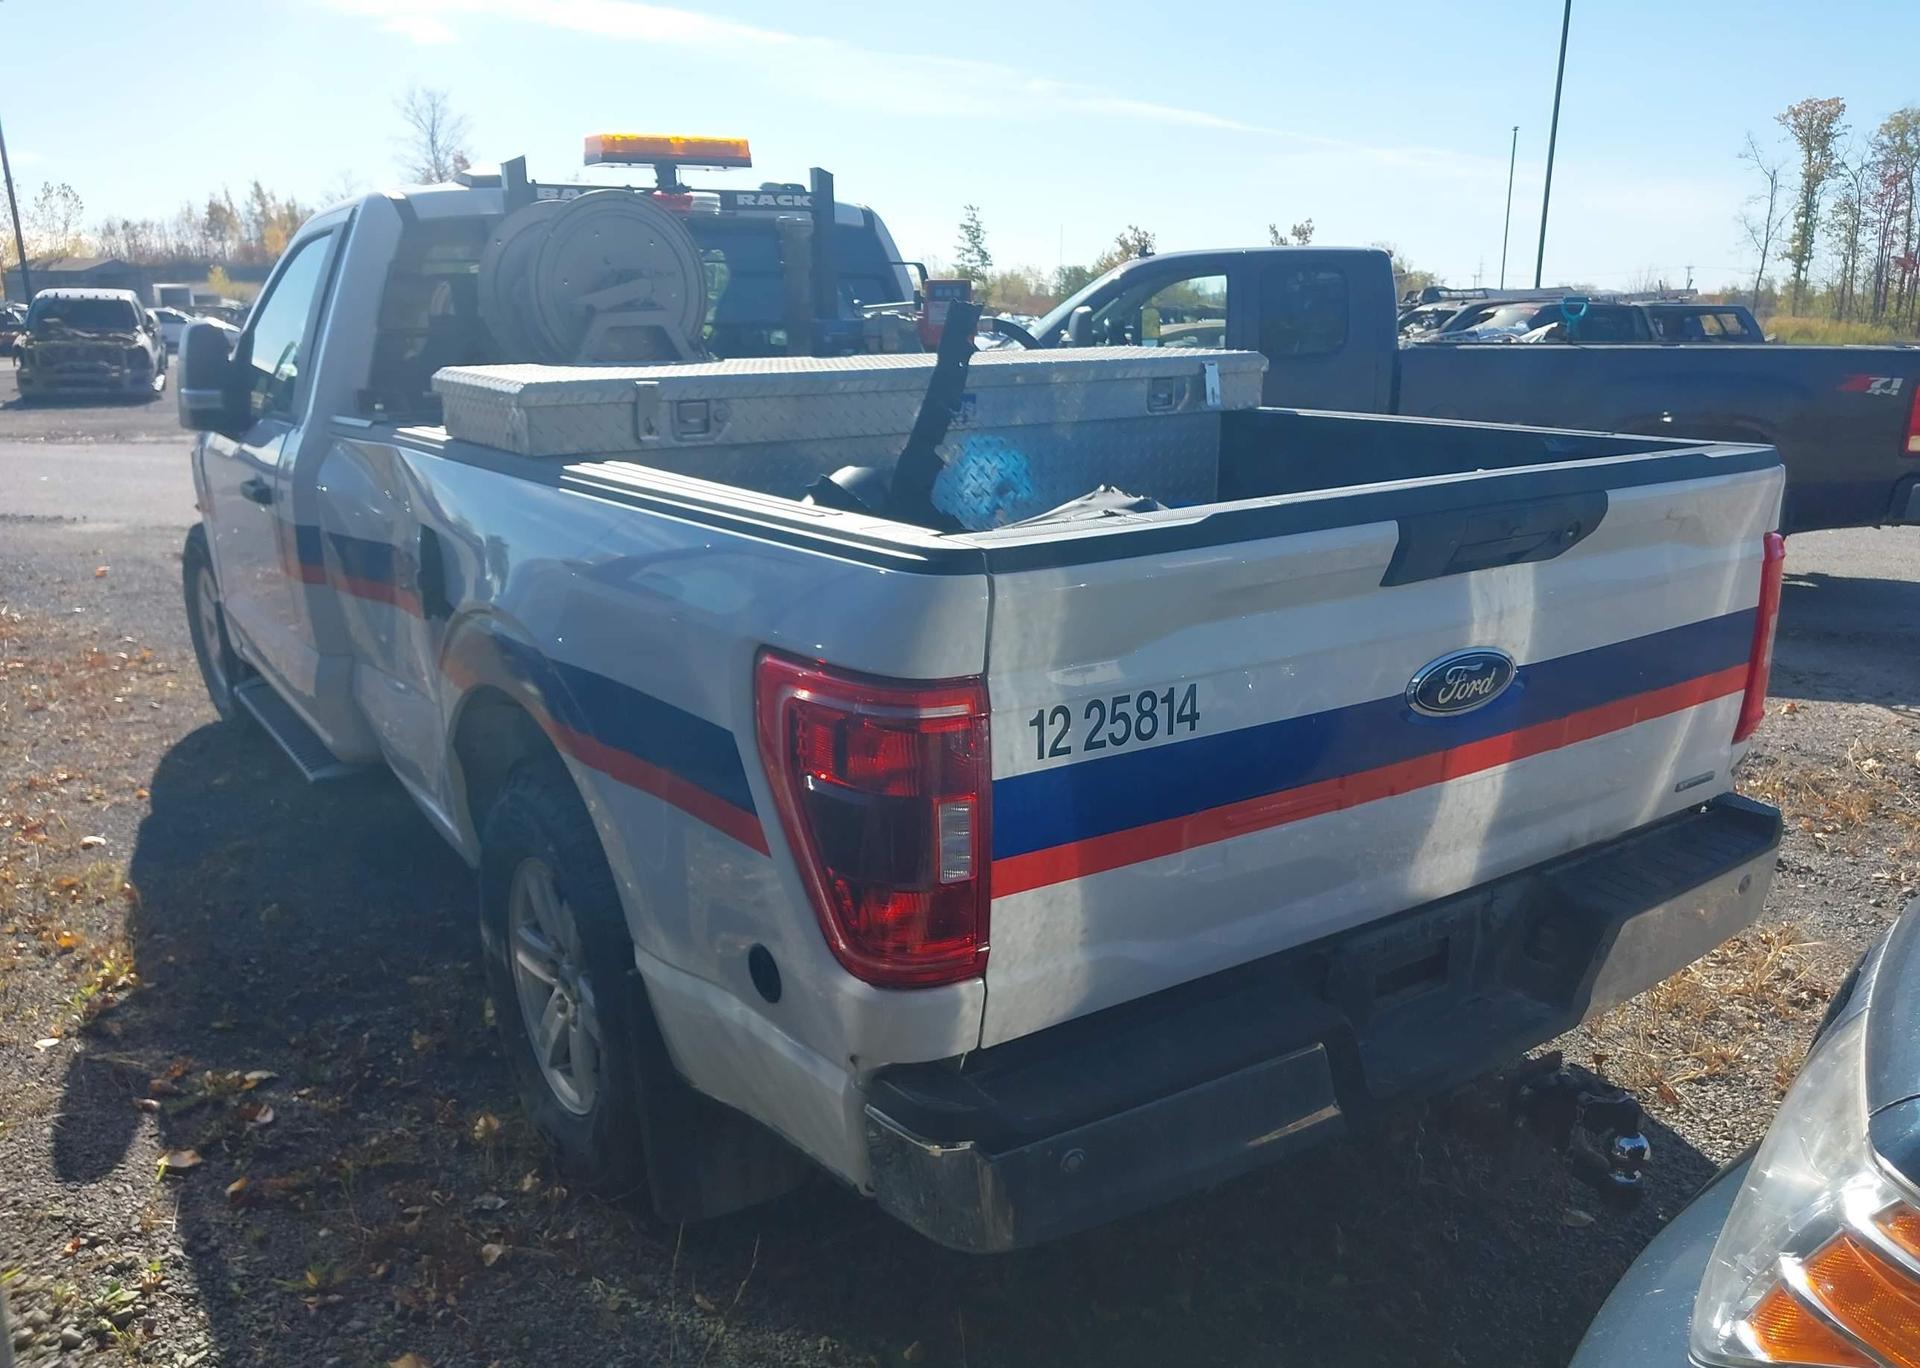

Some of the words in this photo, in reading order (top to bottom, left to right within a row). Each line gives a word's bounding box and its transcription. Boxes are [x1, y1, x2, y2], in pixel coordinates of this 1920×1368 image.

[736, 194, 812, 207] RACK
[1438, 662, 1497, 704] Ford
[1029, 705, 1072, 760] 12
[1083, 683, 1200, 752] 25814
